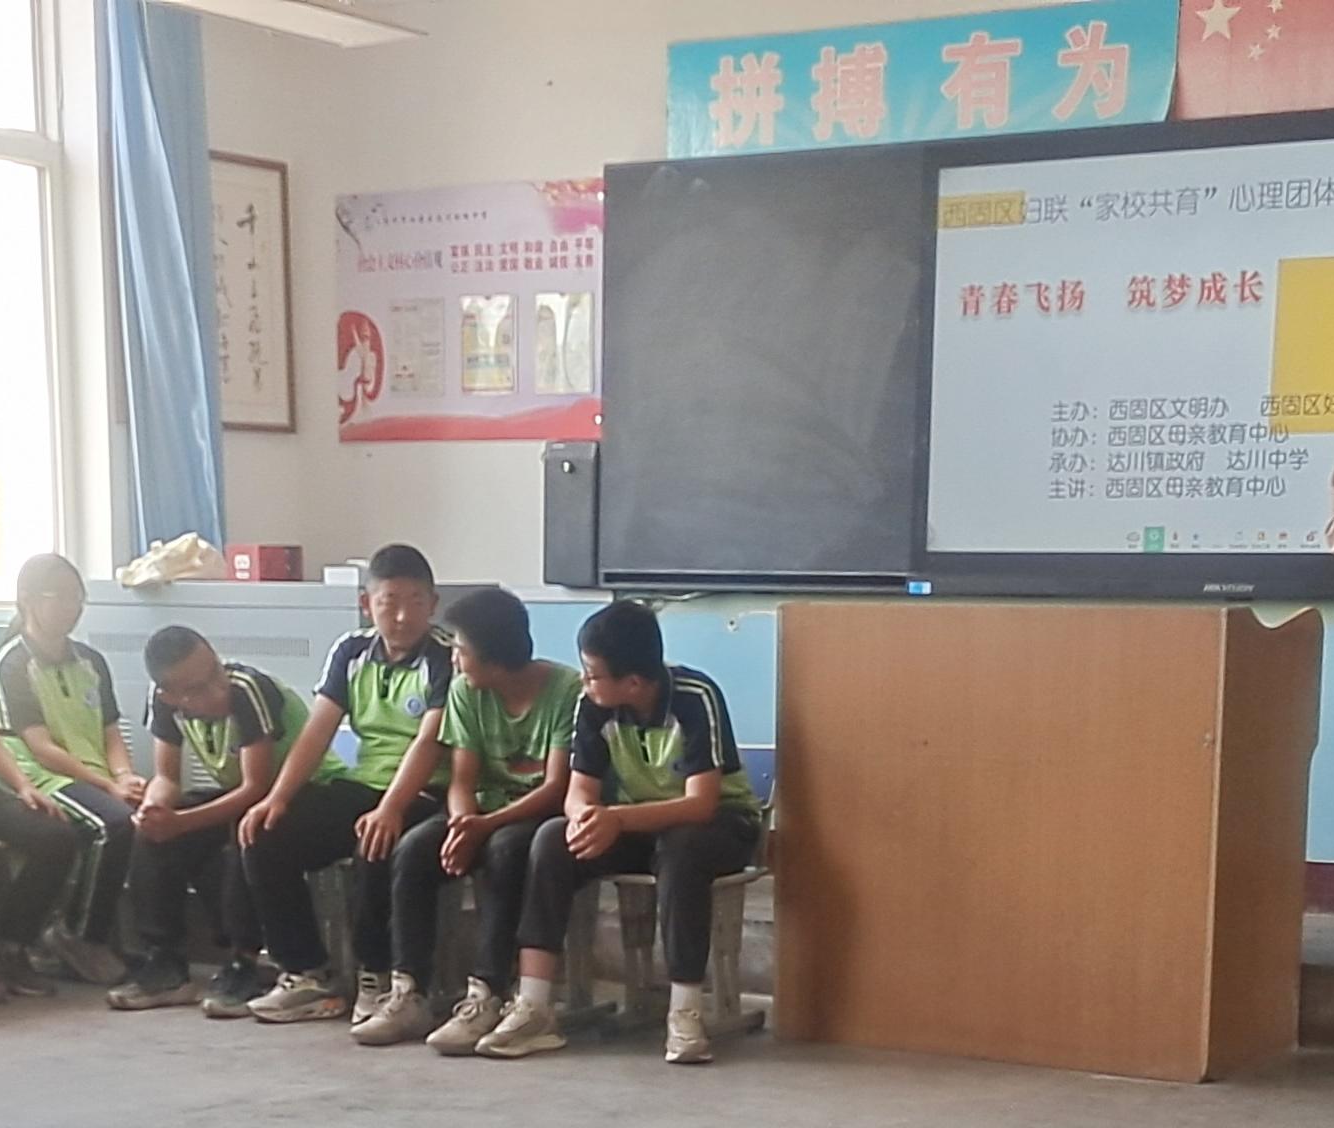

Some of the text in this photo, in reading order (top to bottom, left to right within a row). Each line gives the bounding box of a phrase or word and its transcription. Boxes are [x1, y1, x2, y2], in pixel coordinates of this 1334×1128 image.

[709, 21, 1132, 148] 拼搏有为
[961, 269, 1264, 316] 青春飞扬 筑梦成长
[1226, 448, 1309, 471] 达川中学
